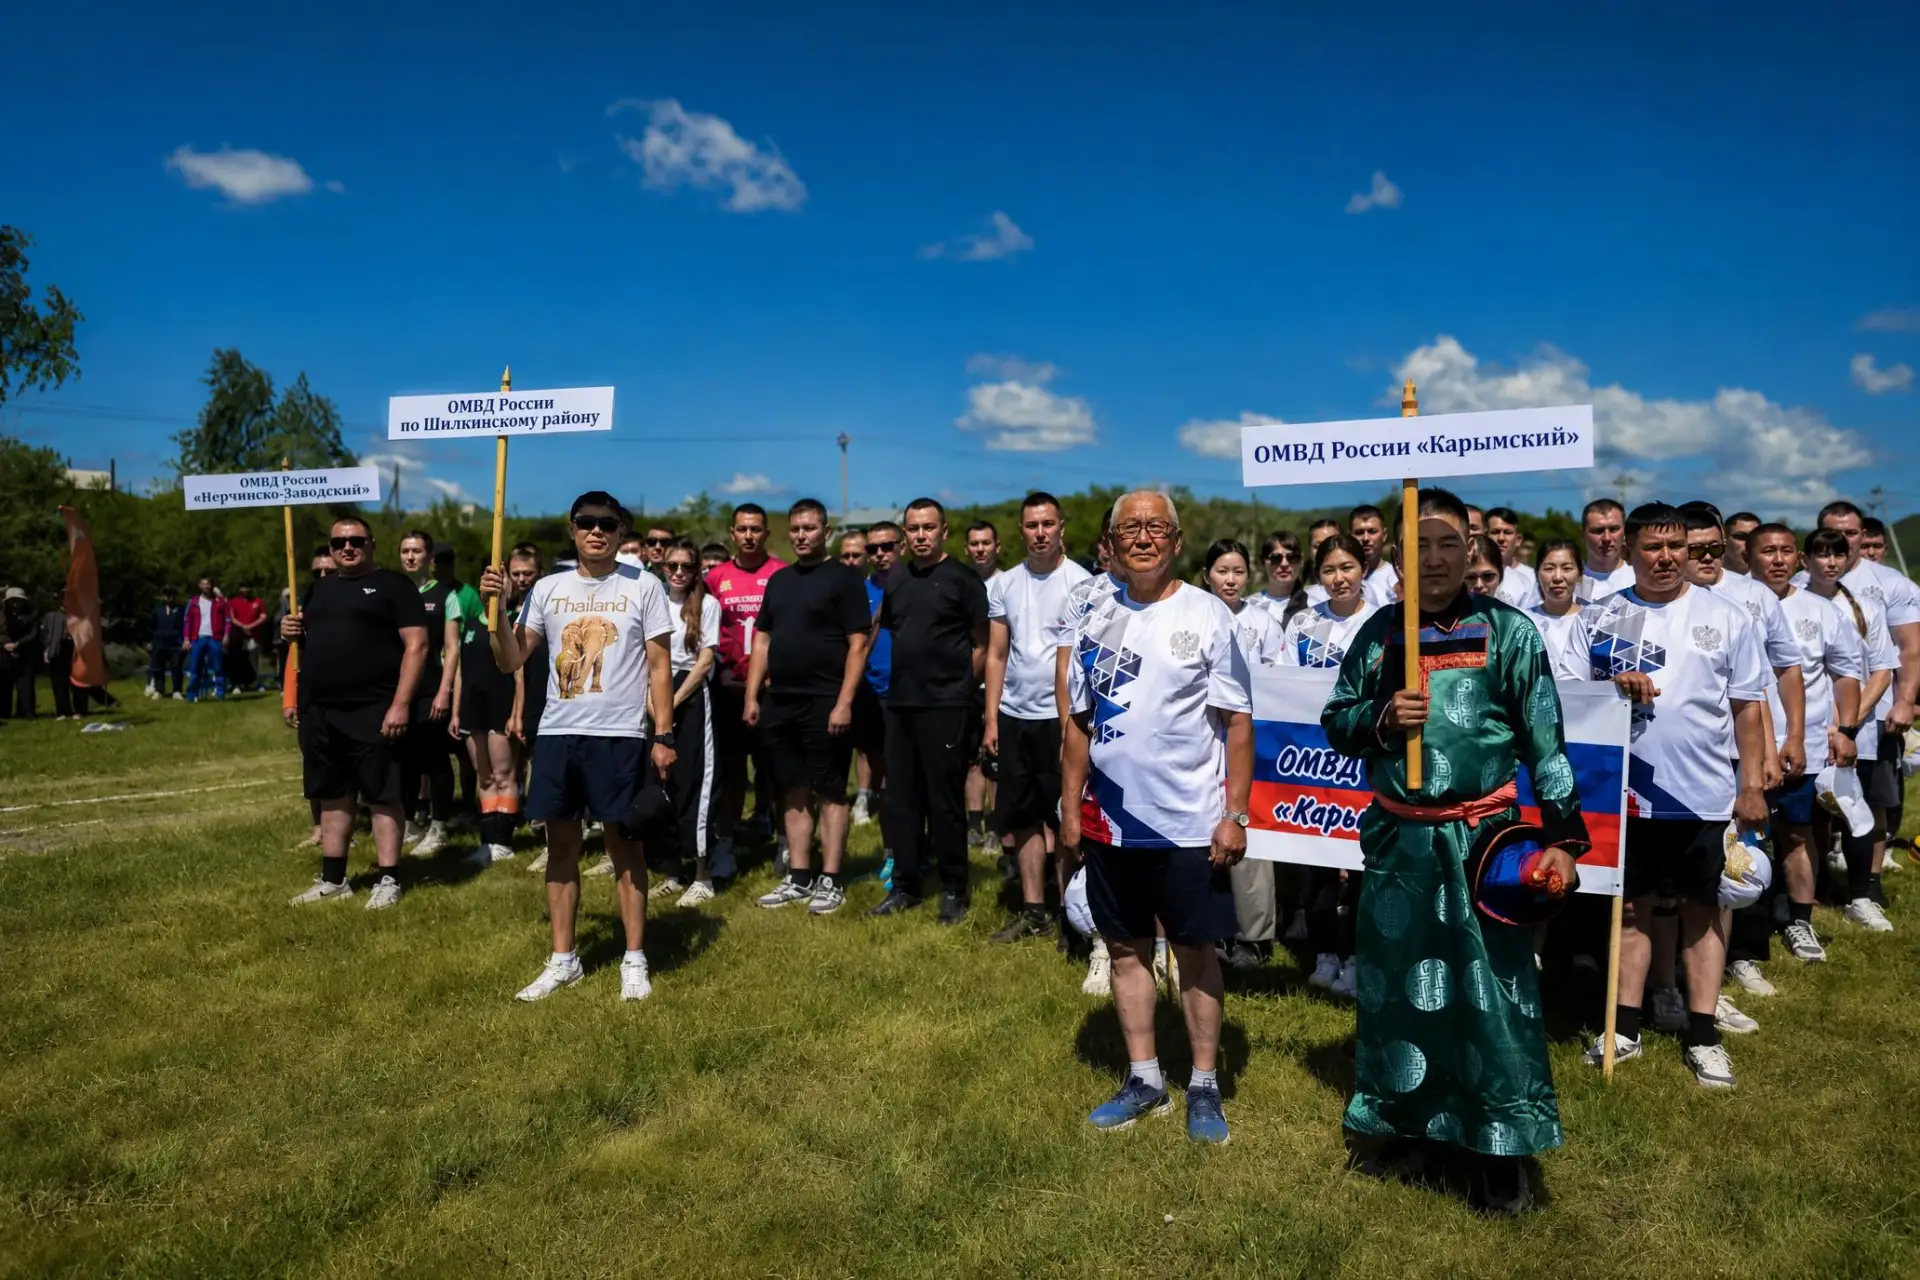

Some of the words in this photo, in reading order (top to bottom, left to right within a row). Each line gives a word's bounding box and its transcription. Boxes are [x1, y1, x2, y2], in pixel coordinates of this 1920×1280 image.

[447, 398, 495, 415] ОМВД
[499, 398, 554, 412] России
[400, 421, 420, 432] по
[423, 416, 539, 431] Шилкинскому
[542, 411, 600, 429] району
[1254, 442, 1325, 465] ОМВД
[1331, 441, 1411, 460] России
[1416, 426, 1580, 457] «Карымский»
[239, 475, 279, 489] ОМВД
[282, 474, 328, 487] России
[193, 483, 371, 505] «Нерчинско-Заводский»
[551, 594, 628, 615] Thailand
[1277, 746, 1361, 786] ОМВД
[1273, 795, 1368, 836] «Кары
